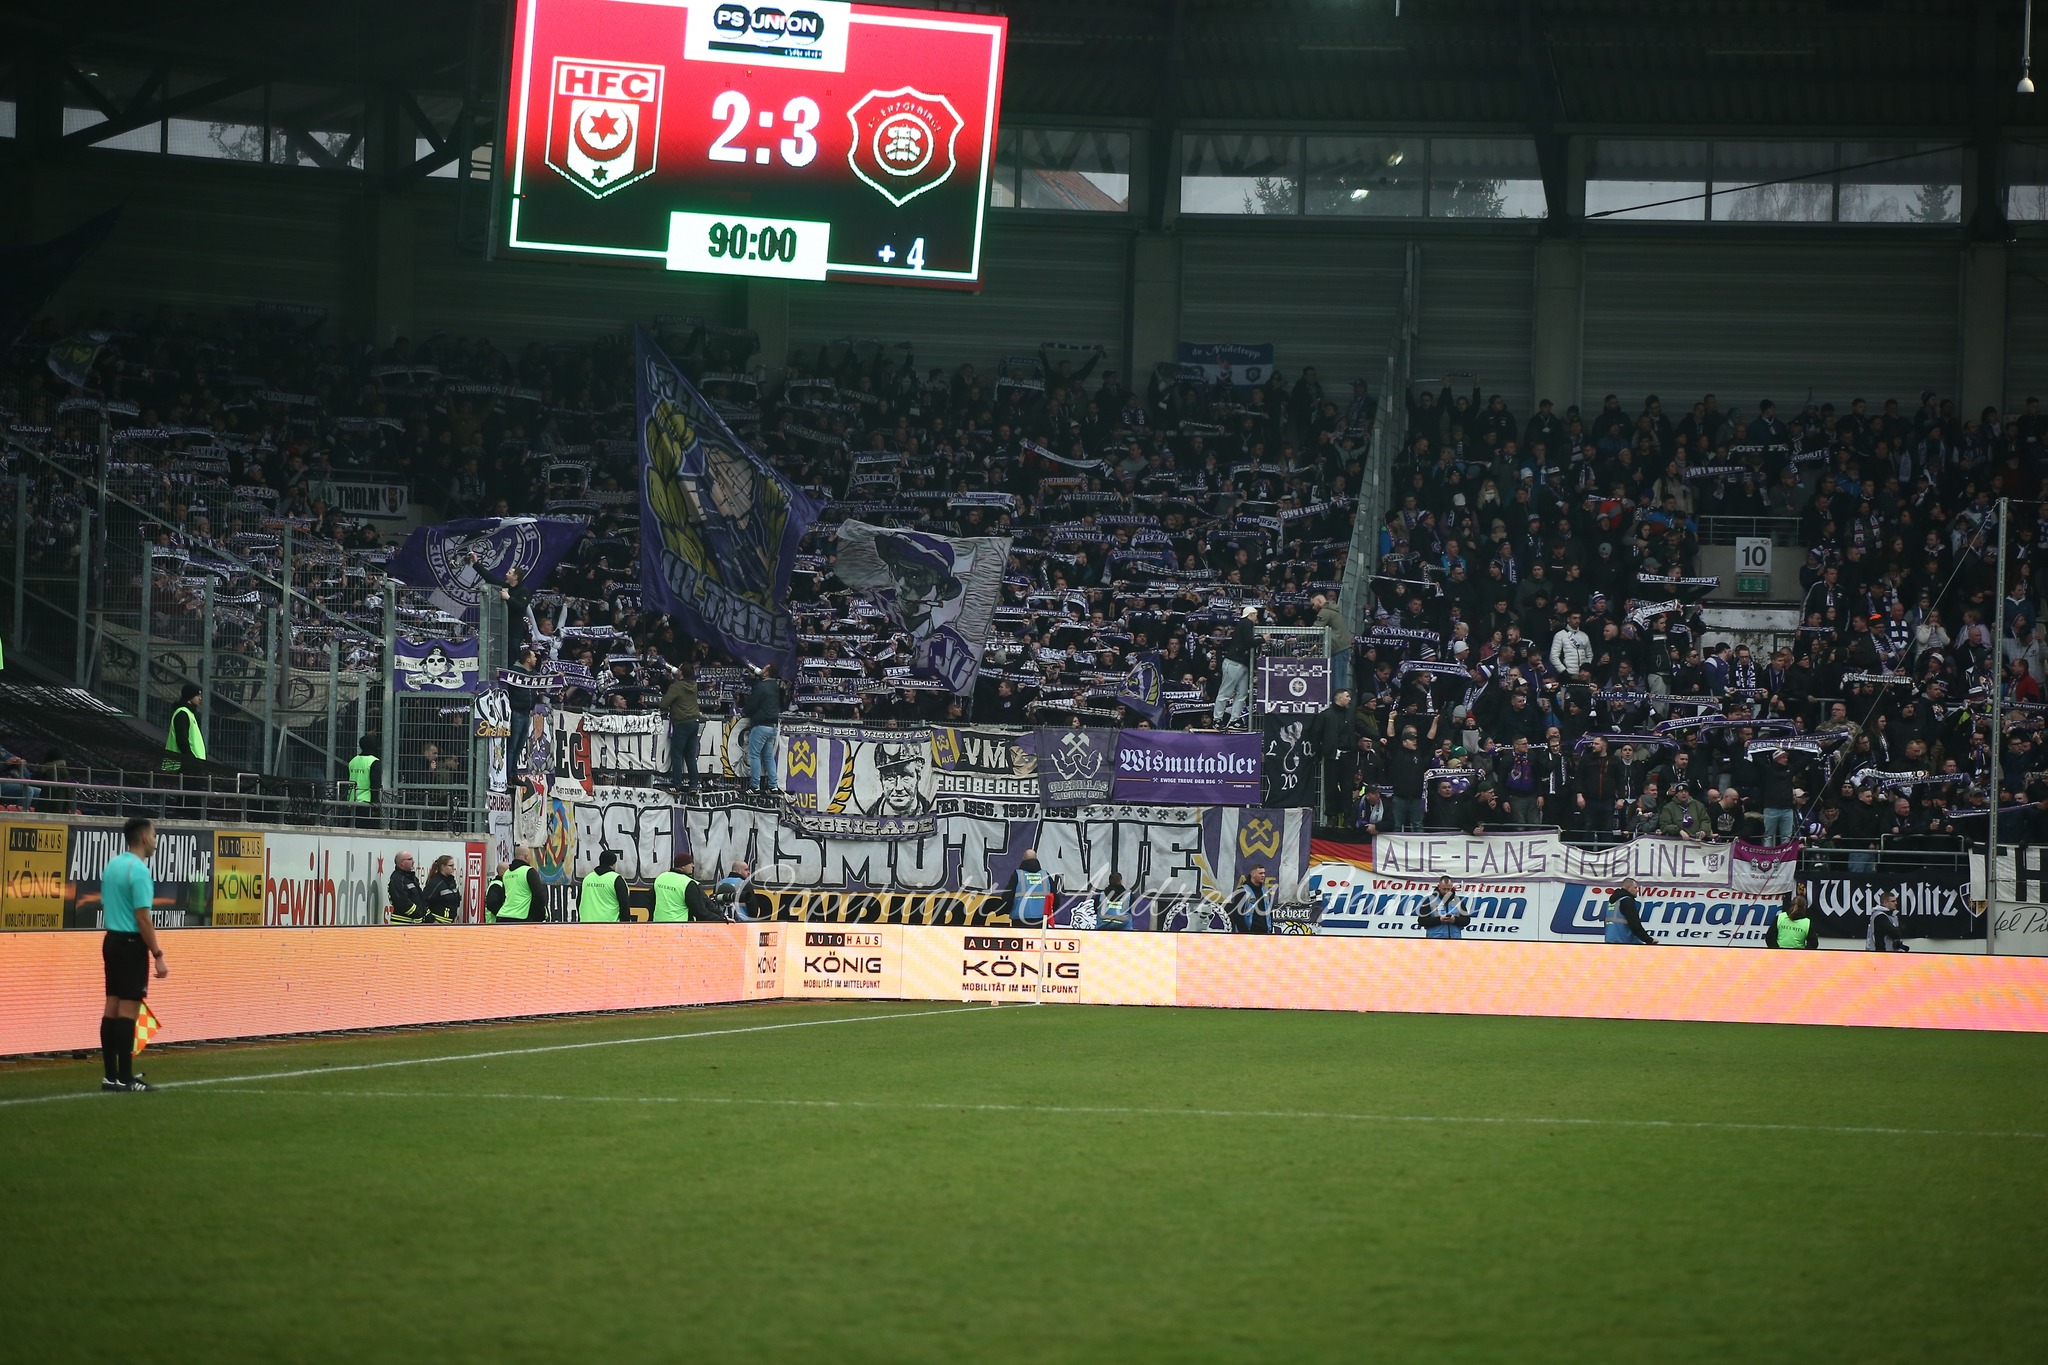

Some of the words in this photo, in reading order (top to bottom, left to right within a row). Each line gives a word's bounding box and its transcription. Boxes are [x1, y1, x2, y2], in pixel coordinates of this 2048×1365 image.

[717, 10, 745, 27] PS
[750, 13, 817, 33] UNION
[565, 69, 650, 99] HFC
[709, 90, 820, 167] 2:3
[708, 222, 796, 263] 90:00
[1742, 546, 1767, 567] 10
[1120, 748, 1257, 775] Wismutadler
[10, 831, 63, 851] AUTOHAUS
[218, 838, 262, 857] AUTOHAUS
[575, 801, 674, 884] BSG
[685, 803, 1010, 894] WISMUT
[1035, 819, 1203, 897] AUE
[6, 860, 61, 899] KÖNIG
[217, 866, 262, 900] KÖNIG
[808, 935, 879, 946] AUTOHAUS
[968, 937, 1076, 952] AUTOHAUS
[1683, 928, 1713, 939] der
[804, 951, 881, 974] KÖNIG
[962, 955, 1079, 979] KÖNIG
[803, 979, 833, 989] MOBILITÄT
[834, 980, 842, 989] IM
[843, 980, 880, 989] MITTELPUNKT
[962, 982, 1006, 993] MOBILITÄT
[1007, 984, 1019, 993] IM
